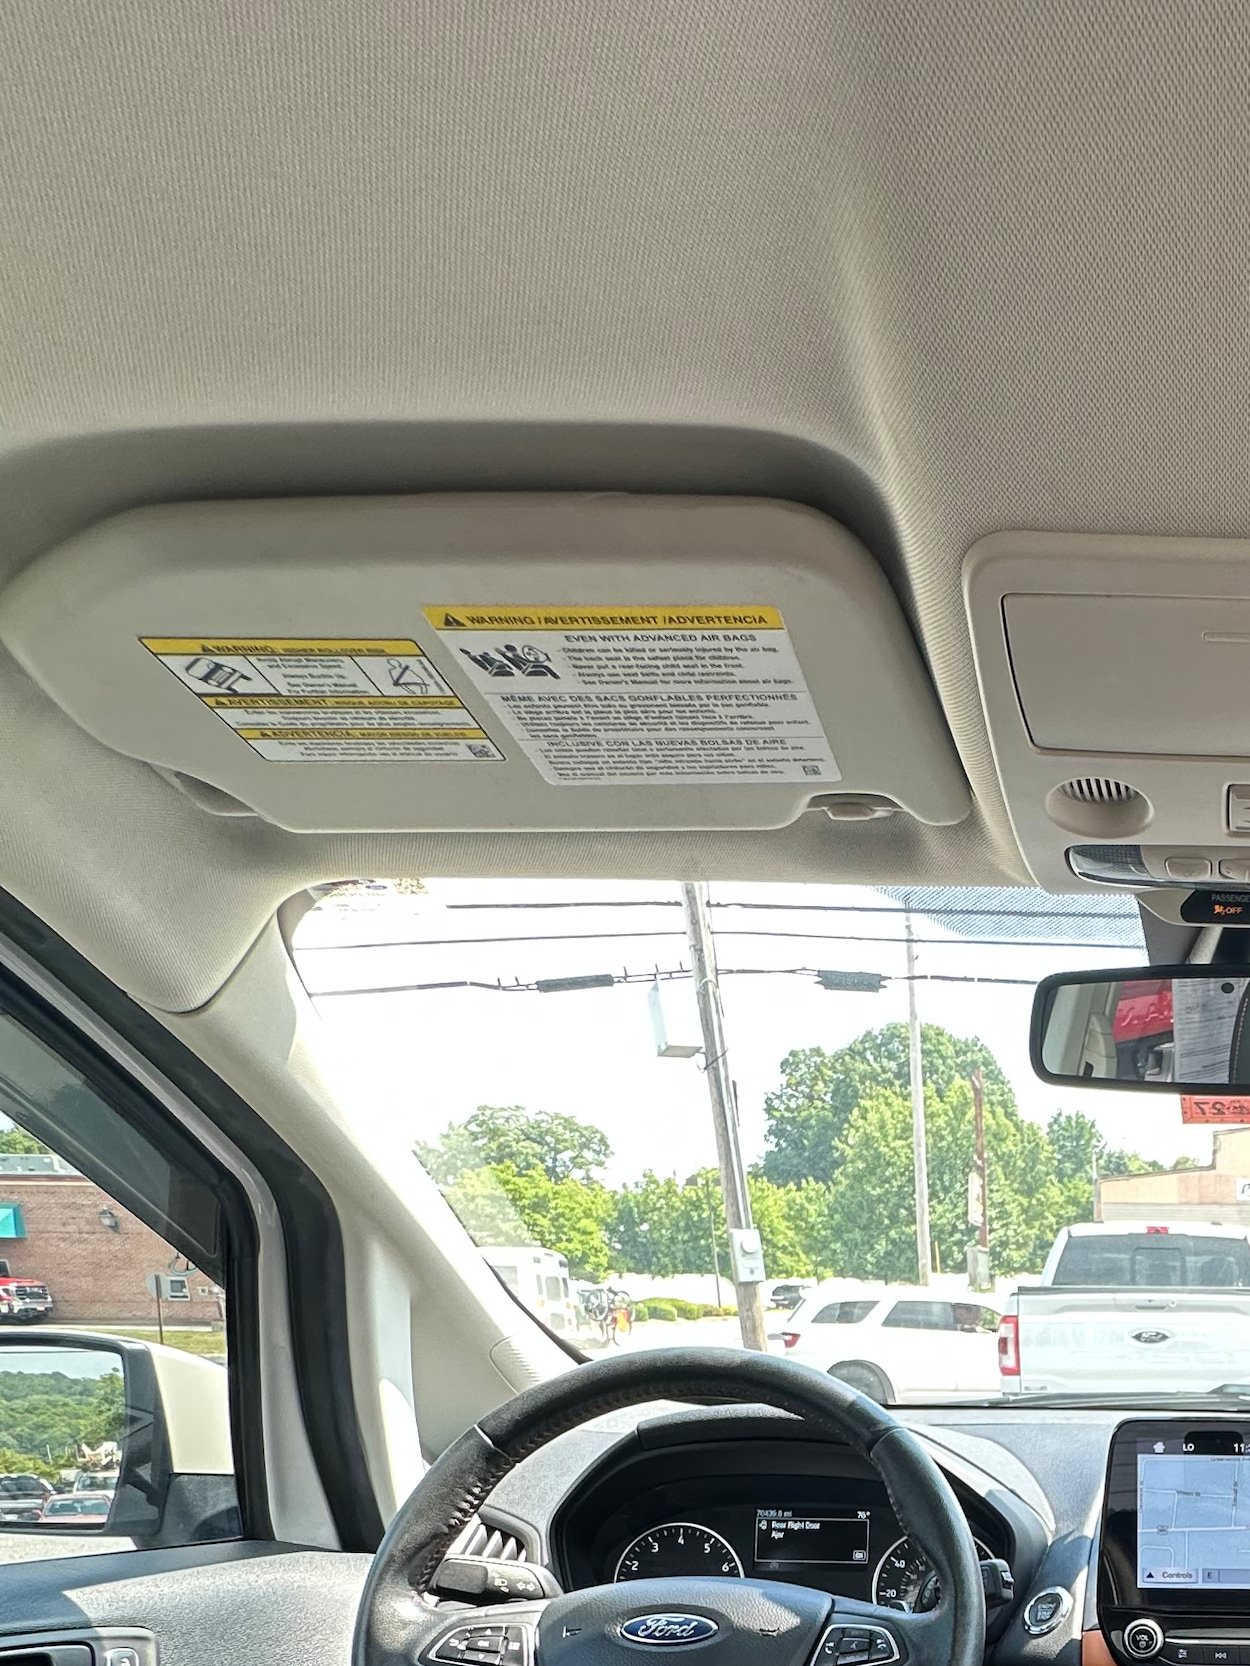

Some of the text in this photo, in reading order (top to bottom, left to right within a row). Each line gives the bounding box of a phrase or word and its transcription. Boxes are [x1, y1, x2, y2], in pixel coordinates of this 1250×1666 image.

[466, 616, 535, 624] WARNING
[564, 634, 757, 643] EVEN WITH ADVANCED AIR BAGS
[1225, 906, 1243, 914] OFF
[1182, 1443, 1195, 1452] LO
[805, 1522, 820, 1530] Door
[678, 1535, 684, 1545] 4
[651, 1542, 660, 1553] 3
[704, 1543, 712, 1554] 5
[631, 1560, 640, 1571] 2
[722, 1562, 730, 1572] 6
[894, 1560, 906, 1568] 40
[1162, 1571, 1193, 1579] Controls
[1207, 1572, 1212, 1580] E
[886, 1589, 897, 1598] 20
[637, 1616, 700, 1637] Ford
[1135, 1634, 1150, 1642] VOL
